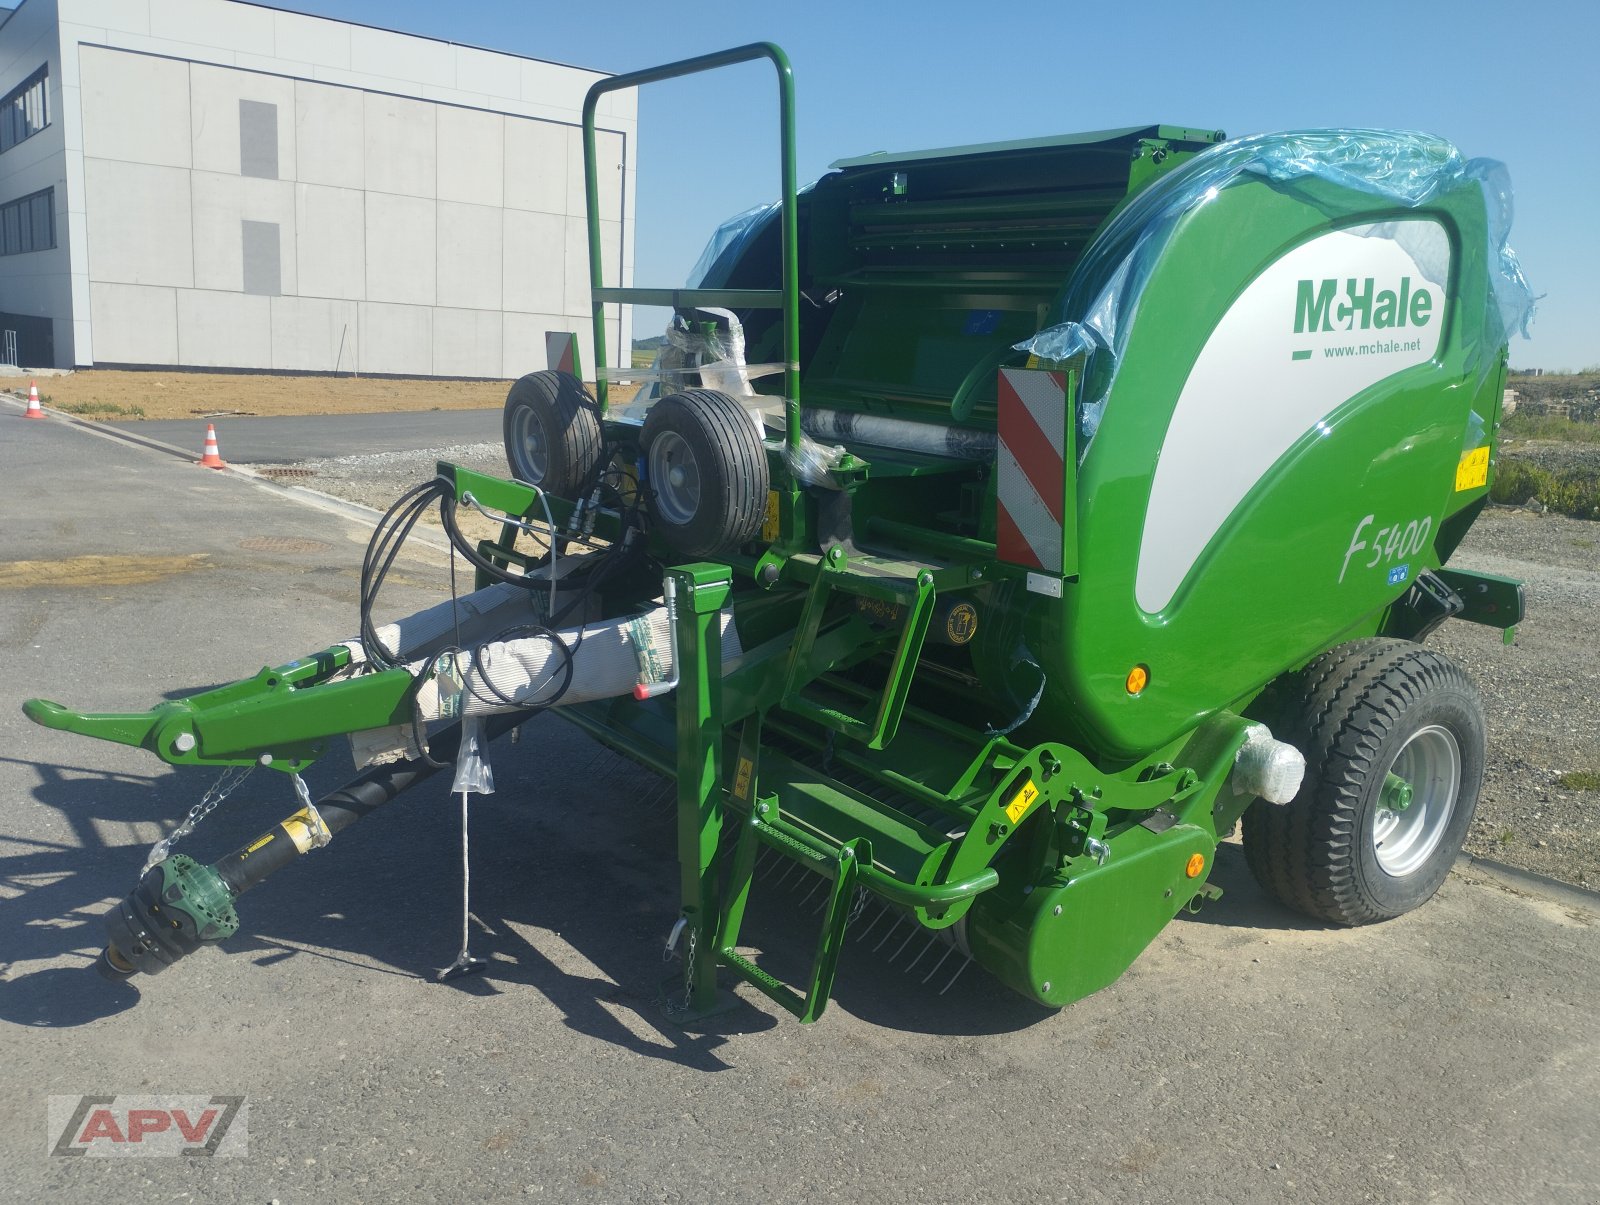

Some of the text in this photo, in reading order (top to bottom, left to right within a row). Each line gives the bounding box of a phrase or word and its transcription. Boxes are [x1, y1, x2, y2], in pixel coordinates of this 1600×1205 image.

[1293, 277, 1433, 334] McHale
[1324, 338, 1421, 358] www.mchale.net
[1338, 514, 1432, 584] F 5400
